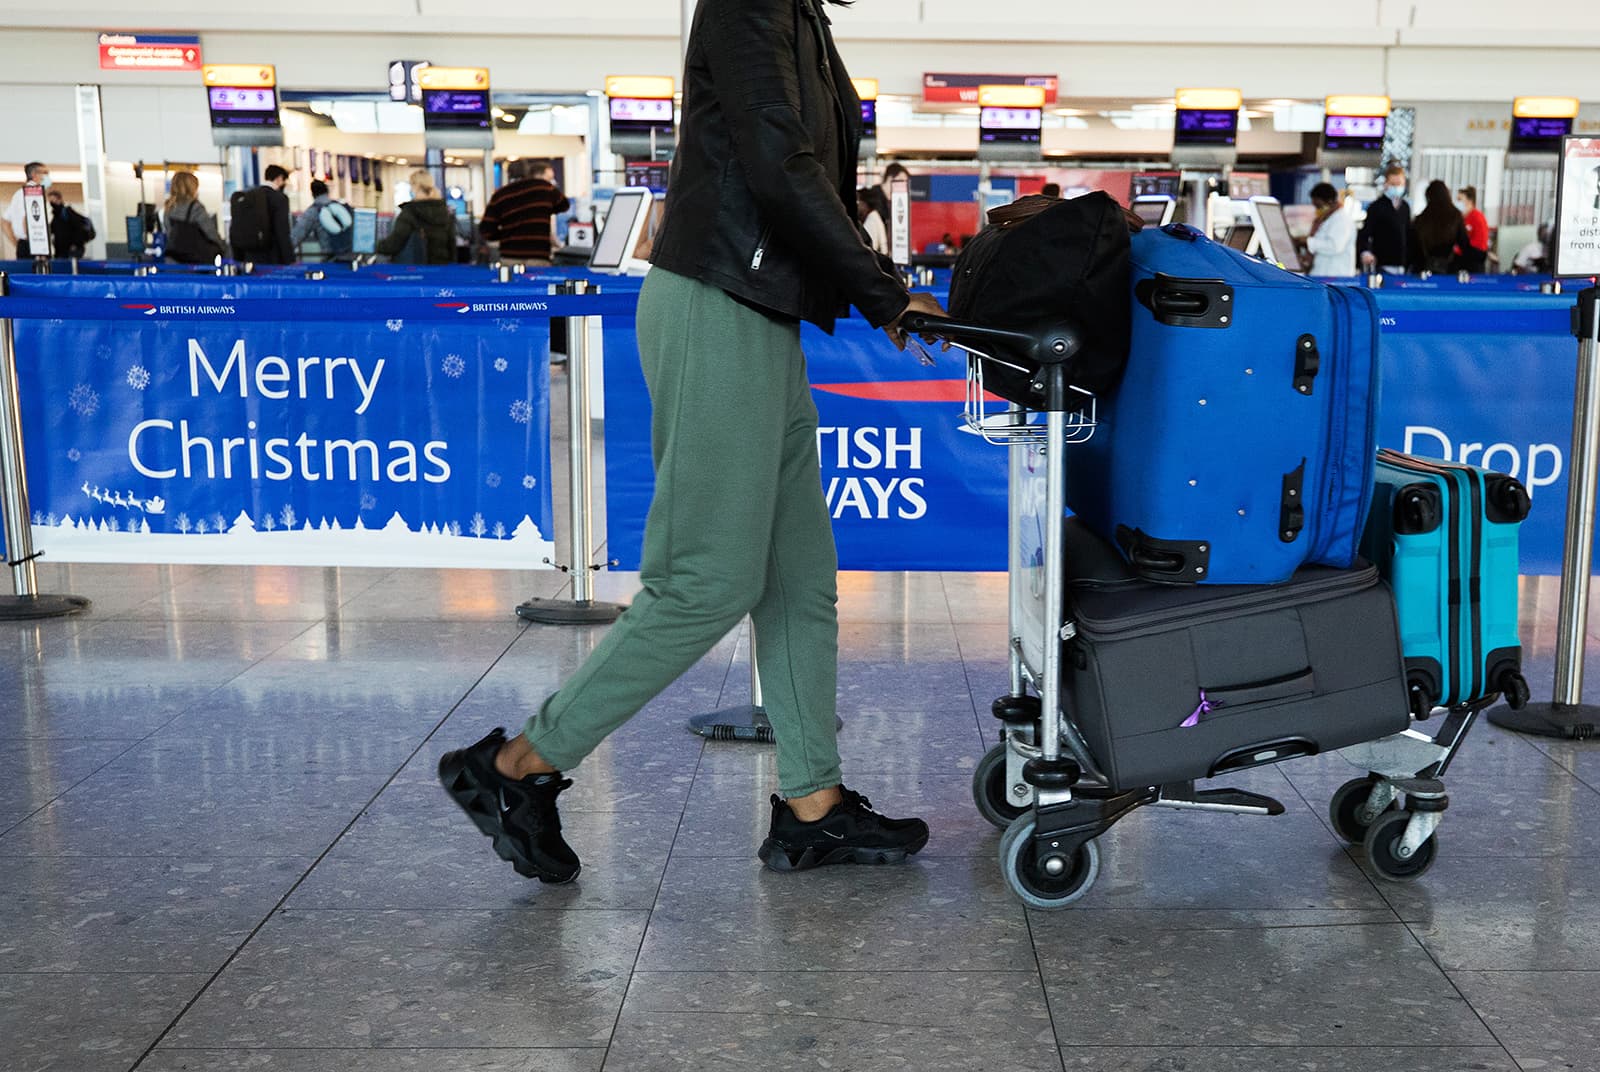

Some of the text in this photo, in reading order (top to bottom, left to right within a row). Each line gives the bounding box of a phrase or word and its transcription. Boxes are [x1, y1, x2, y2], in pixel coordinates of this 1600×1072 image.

[1573, 216, 1598, 226] Kp
[1580, 227, 1600, 236] dist
[1570, 240, 1594, 249] from
[159, 305, 236, 314] BRITISH AIRWAYS
[472, 302, 548, 312] BRITISH AIRWAYS
[188, 338, 385, 415] Merry
[128, 419, 451, 483] Christmas
